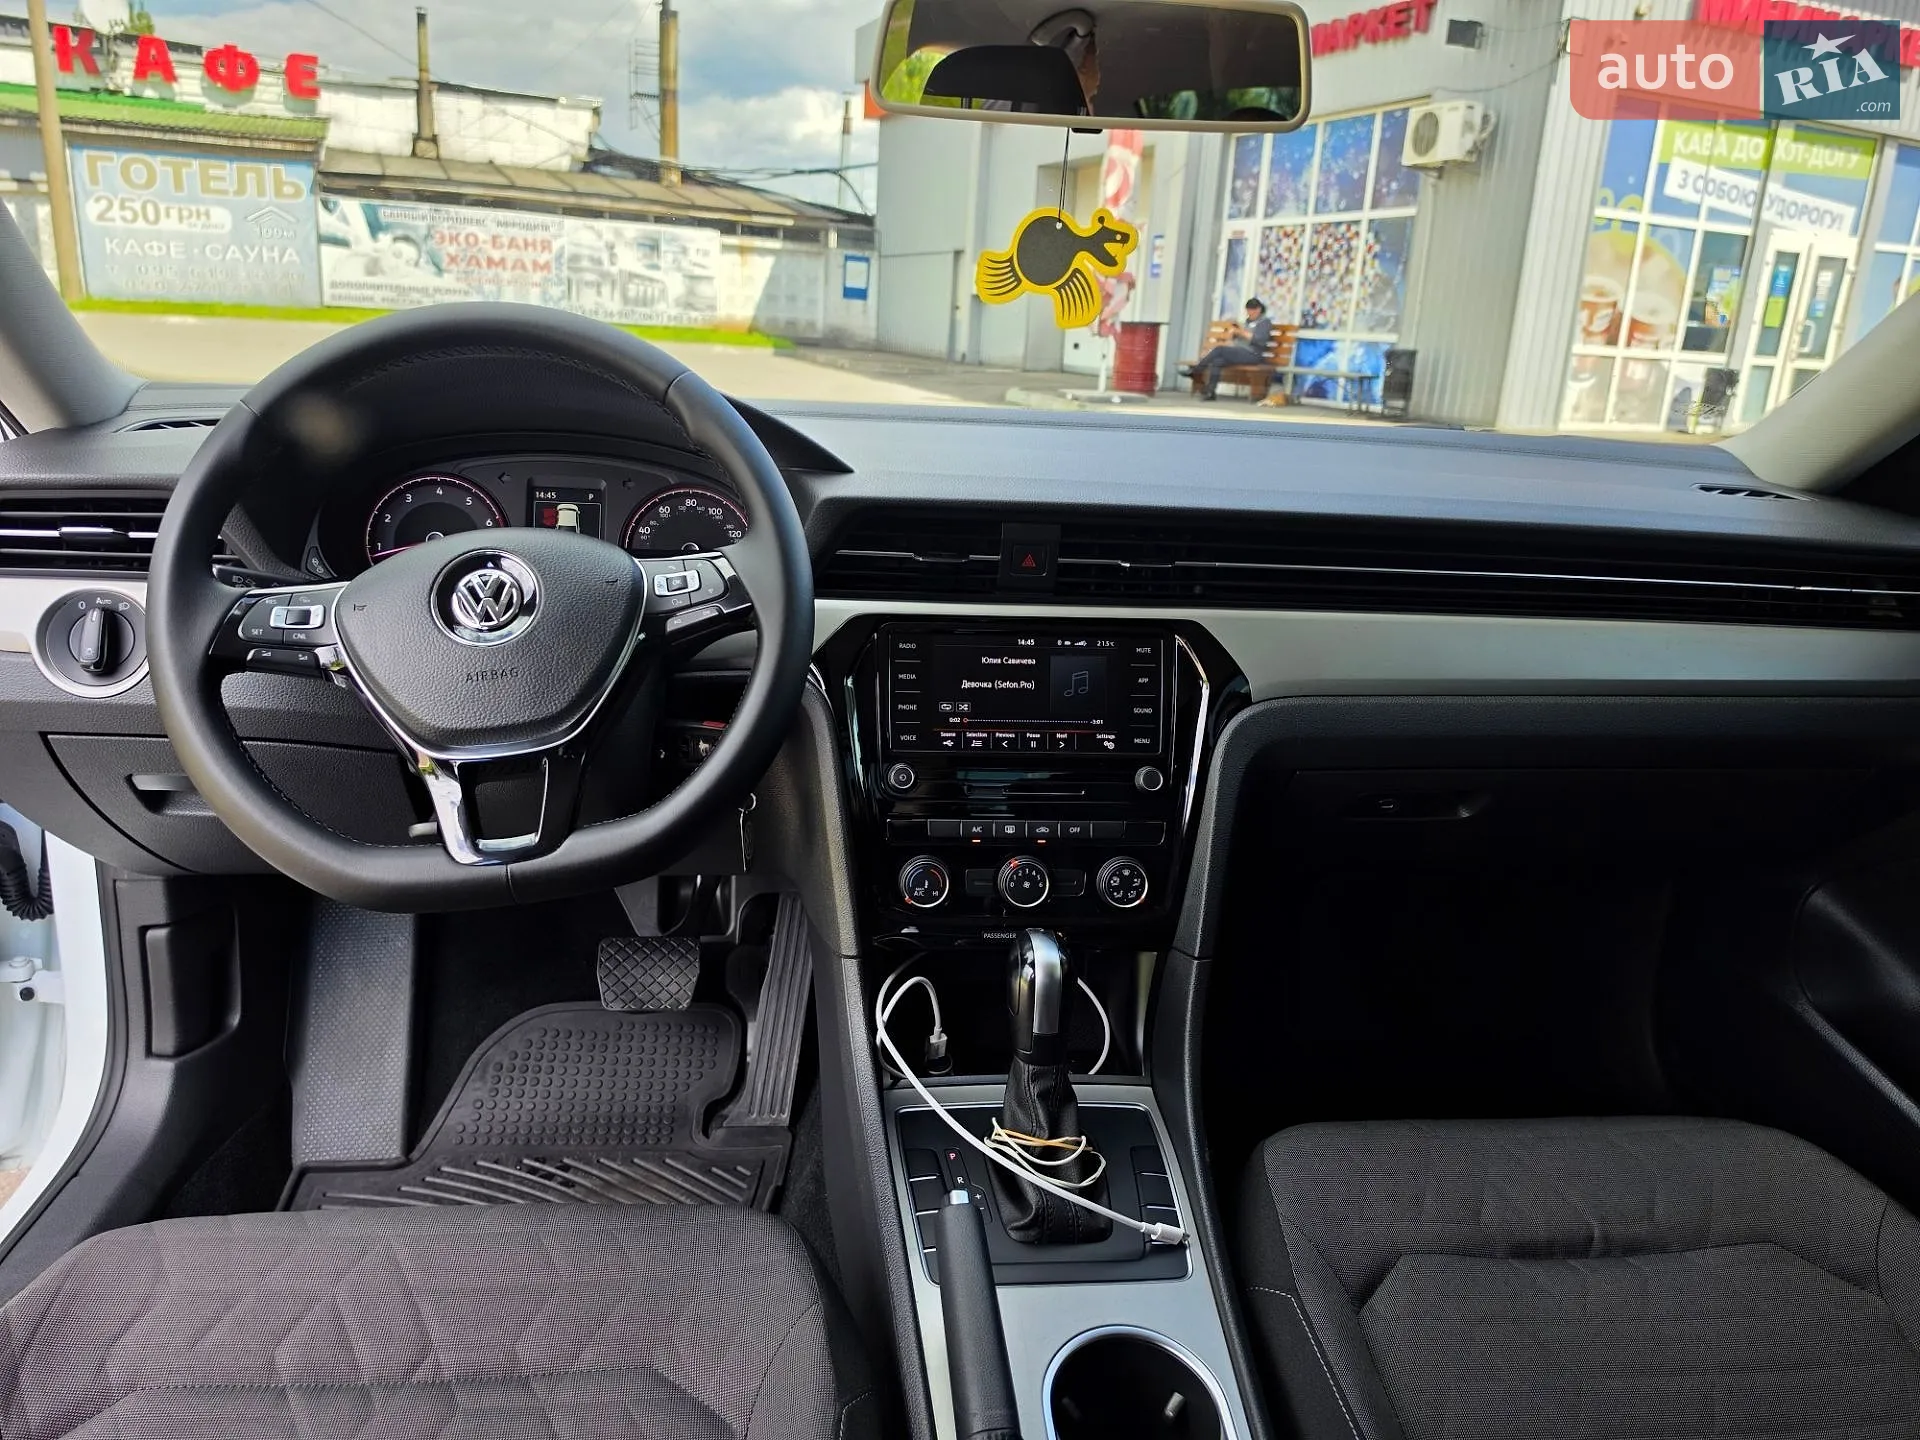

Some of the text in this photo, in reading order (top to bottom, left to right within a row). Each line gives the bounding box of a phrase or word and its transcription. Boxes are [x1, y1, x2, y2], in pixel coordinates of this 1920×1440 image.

[53, 25, 320, 99] КАФЕ
[1673, 129, 1728, 157] КАВА
[1731, 135, 1767, 162] ДО
[83, 149, 307, 202] ГОТЕЛЬ
[1692, 174, 1758, 207] СОБОЮ
[93, 194, 211, 226] 250 грн
[434, 229, 553, 254] ЭКО-БАНЯ
[104, 237, 301, 265] КАФЕ САУНА
[443, 252, 552, 274] ХАМАМ
[436, 487, 443, 495] 4
[535, 491, 557, 499] 14:45
[405, 494, 412, 503] 3
[465, 497, 472, 506] 5
[685, 499, 697, 507] 80
[658, 506, 671, 514] 60
[708, 507, 722, 515] 100
[384, 514, 391, 523] 2
[486, 518, 493, 527] 6
[639, 526, 651, 534] 40
[728, 530, 742, 538] 120
[377, 542, 382, 551] 1
[251, 628, 263, 636] SET
[898, 642, 917, 650] RADIO
[981, 656, 1036, 665] Юлия Савичева
[465, 667, 519, 683] AIRBAG
[961, 680, 1035, 690] Девочка (Sefon.Pro)
[957, 1176, 964, 1184] R
